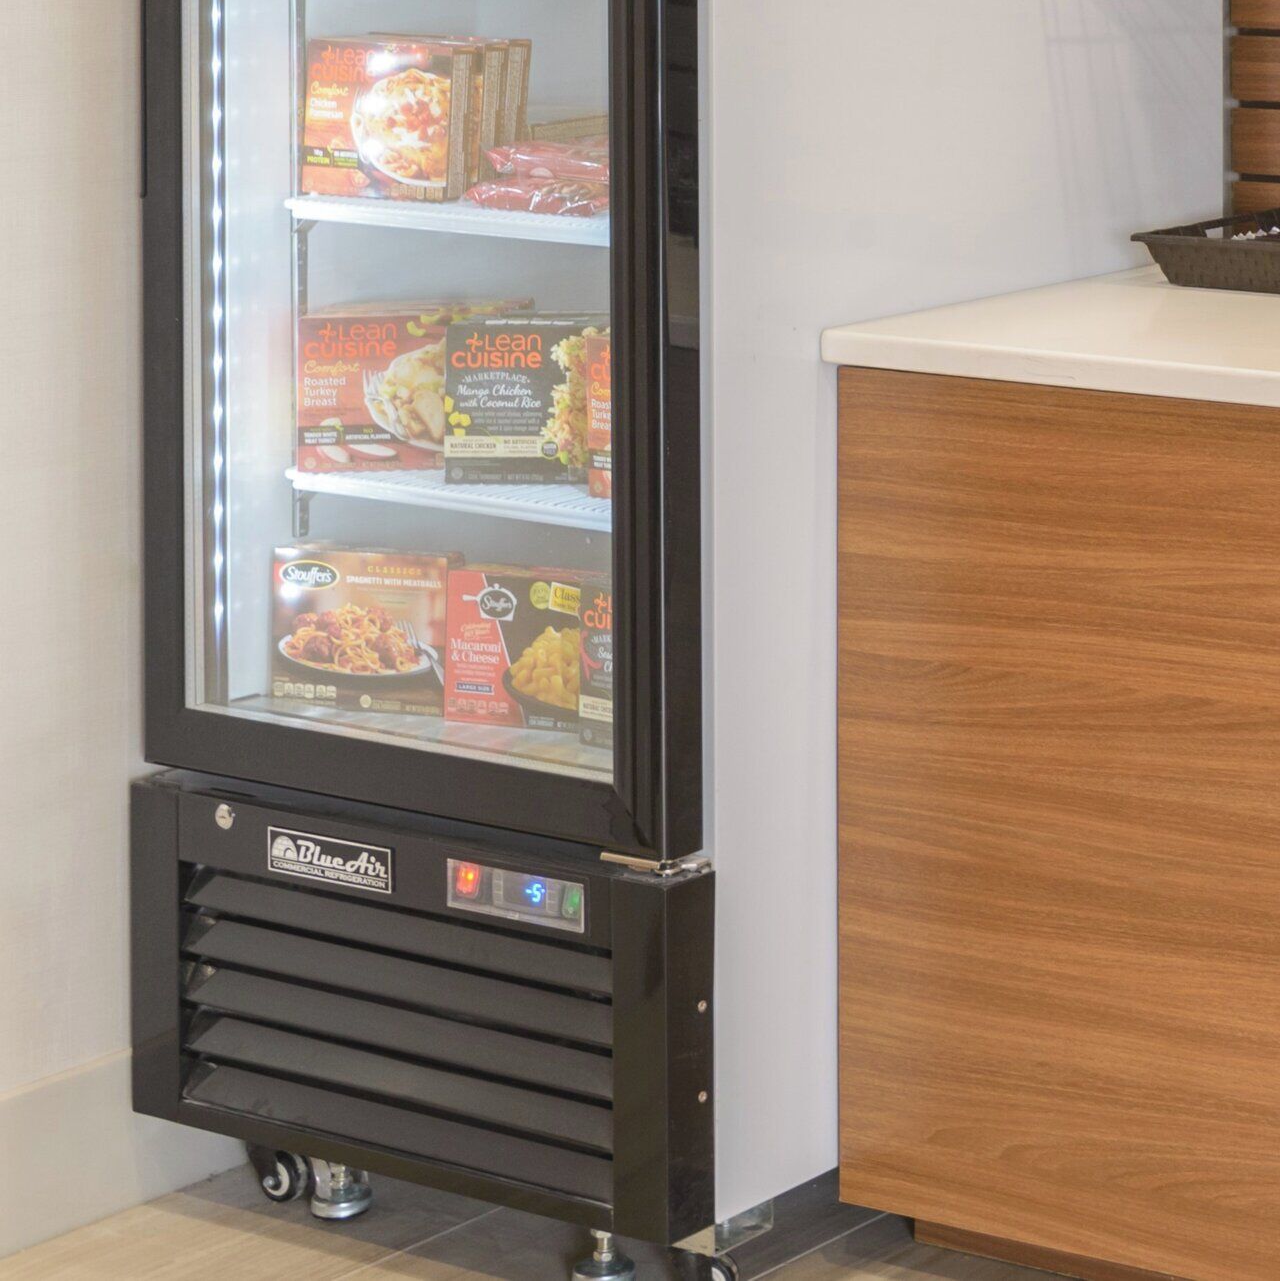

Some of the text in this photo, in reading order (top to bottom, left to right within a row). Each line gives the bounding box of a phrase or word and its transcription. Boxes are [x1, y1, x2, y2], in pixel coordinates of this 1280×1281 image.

[485, 333, 542, 351] Lean
[304, 360, 360, 375] Comfort
[304, 377, 346, 386] Roasted
[304, 388, 337, 398] Turkey
[456, 384, 532, 397] Mango Chicken
[304, 398, 337, 407] Breast
[459, 396, 542, 408] with Coconut Rice
[286, 566, 332, 584] Stouffer's
[346, 575, 441, 588] SPAGHETTI WITH MEATBALLS
[451, 638, 501, 652] Macaroni
[451, 651, 499, 663] & Cheese
[273, 860, 386, 889] COMMERCIAL REFRIGERATION
